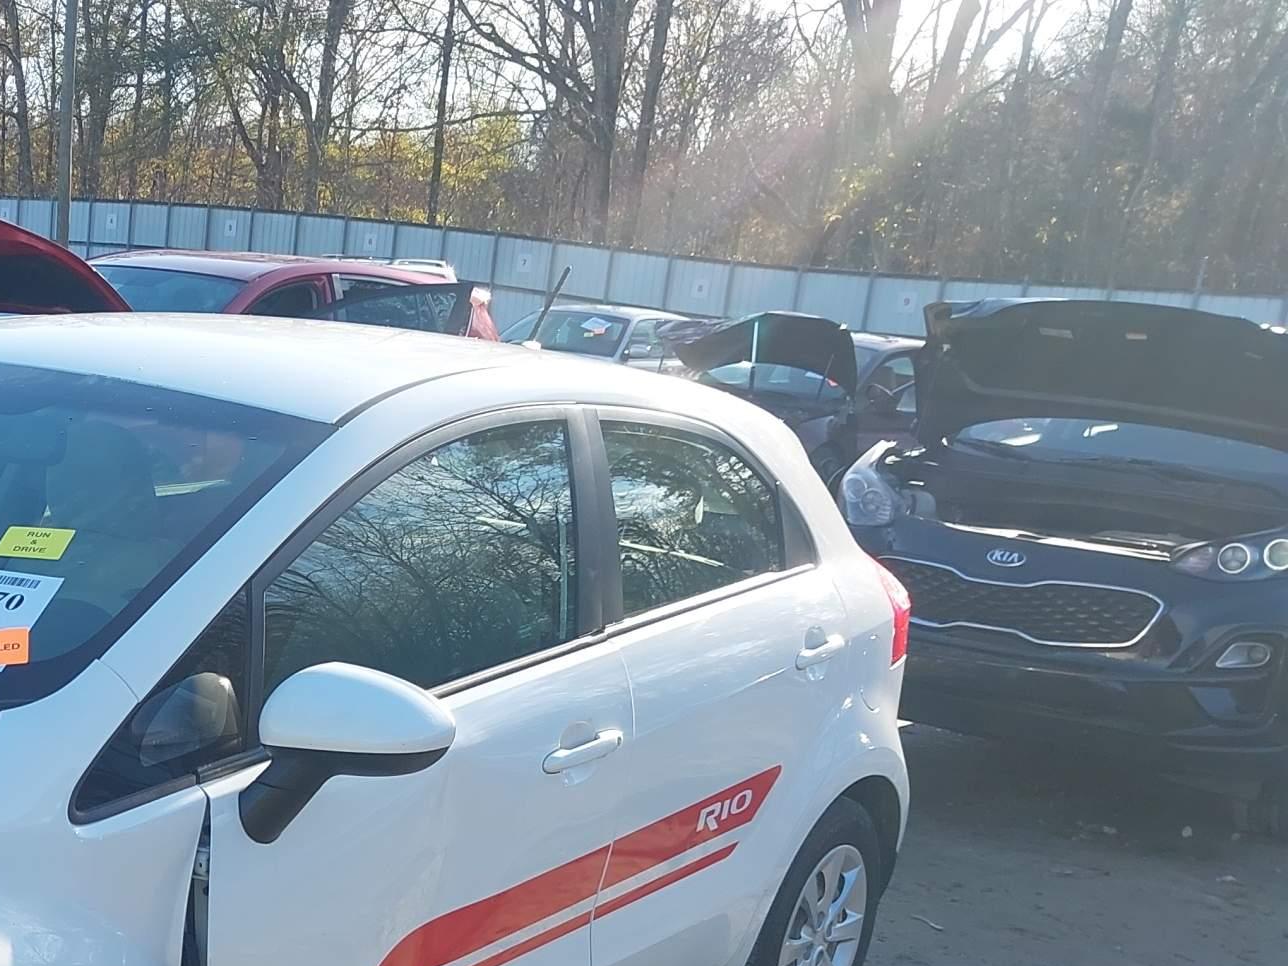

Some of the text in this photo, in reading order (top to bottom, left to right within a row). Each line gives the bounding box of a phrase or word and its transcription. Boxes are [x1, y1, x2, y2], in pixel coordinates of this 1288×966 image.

[12, 546, 48, 554] DRIVE
[992, 550, 1019, 562] KIA
[695, 789, 753, 833] RIO
